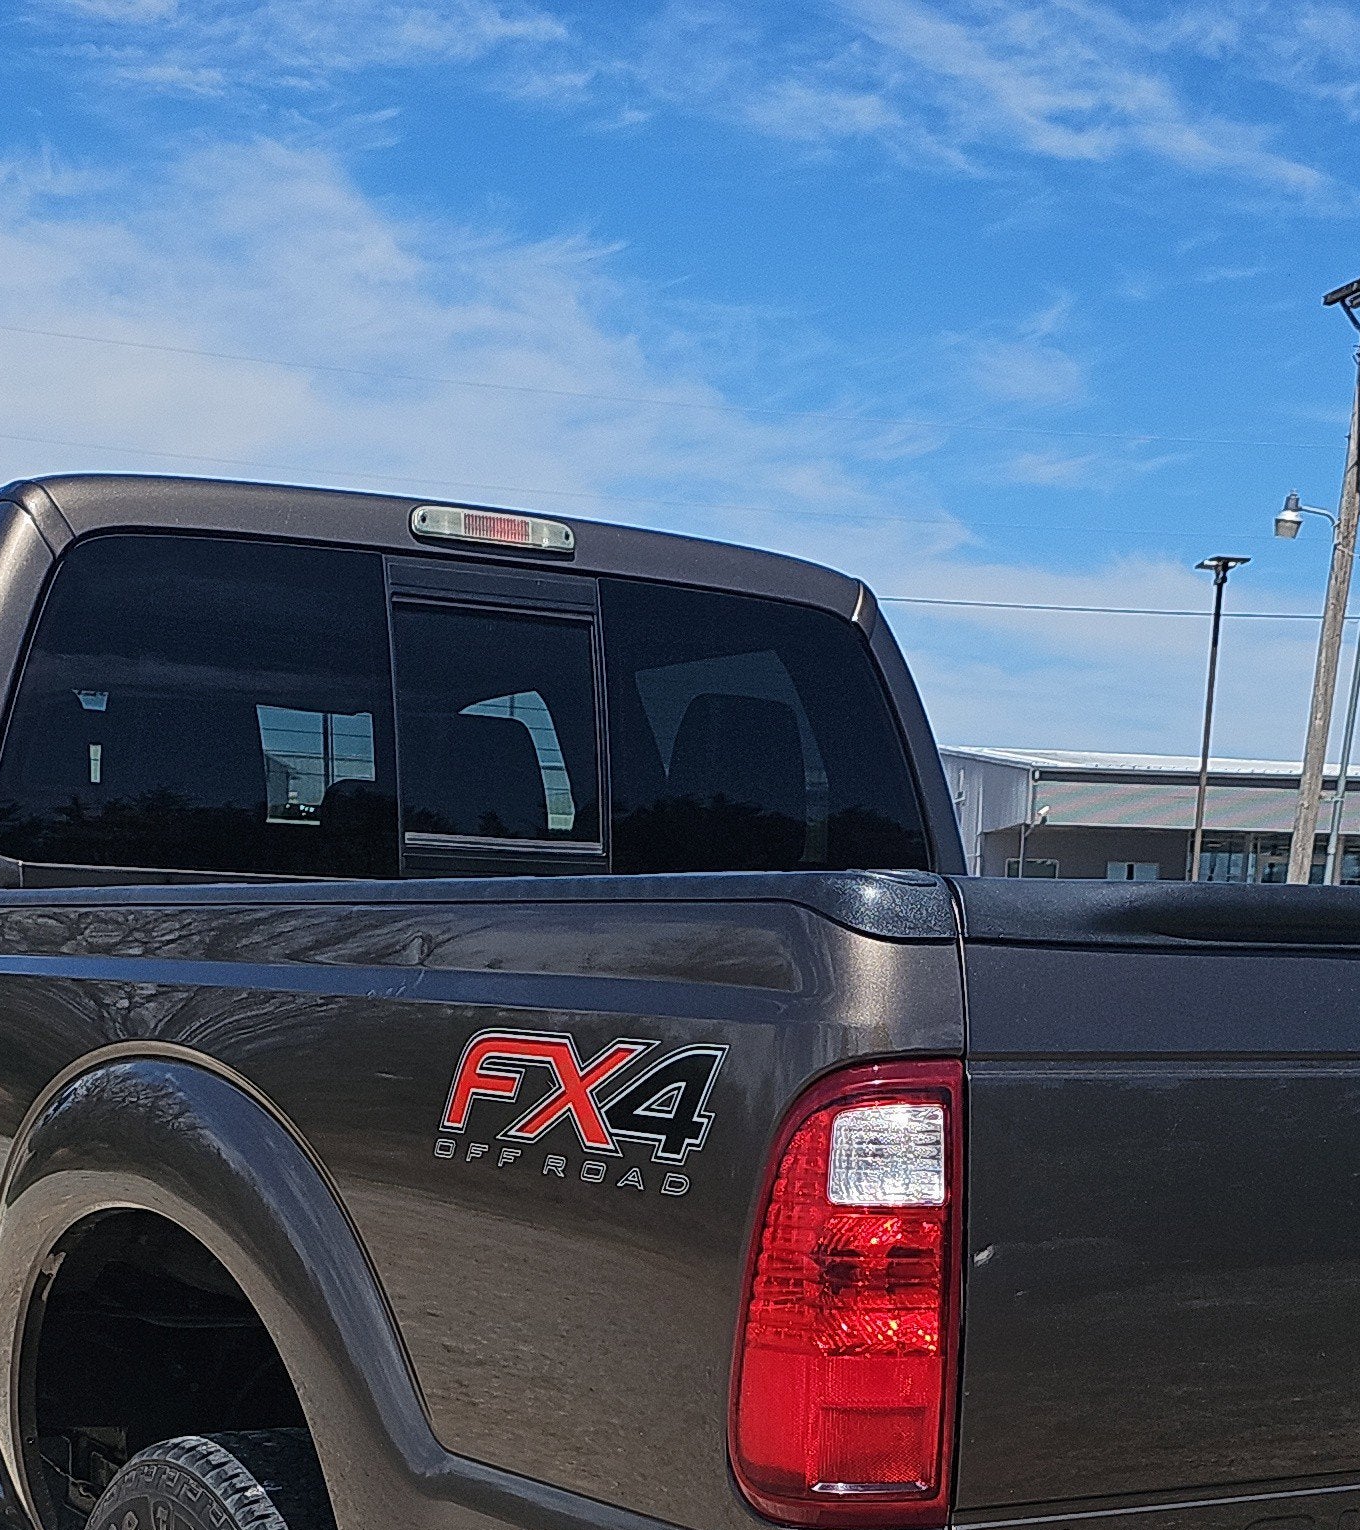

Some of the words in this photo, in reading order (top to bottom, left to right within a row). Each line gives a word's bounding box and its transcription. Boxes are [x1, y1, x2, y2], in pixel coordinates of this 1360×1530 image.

[439, 1027, 730, 1166] FX4
[434, 1138, 522, 1167] OFF
[542, 1154, 690, 1196] ROAD
